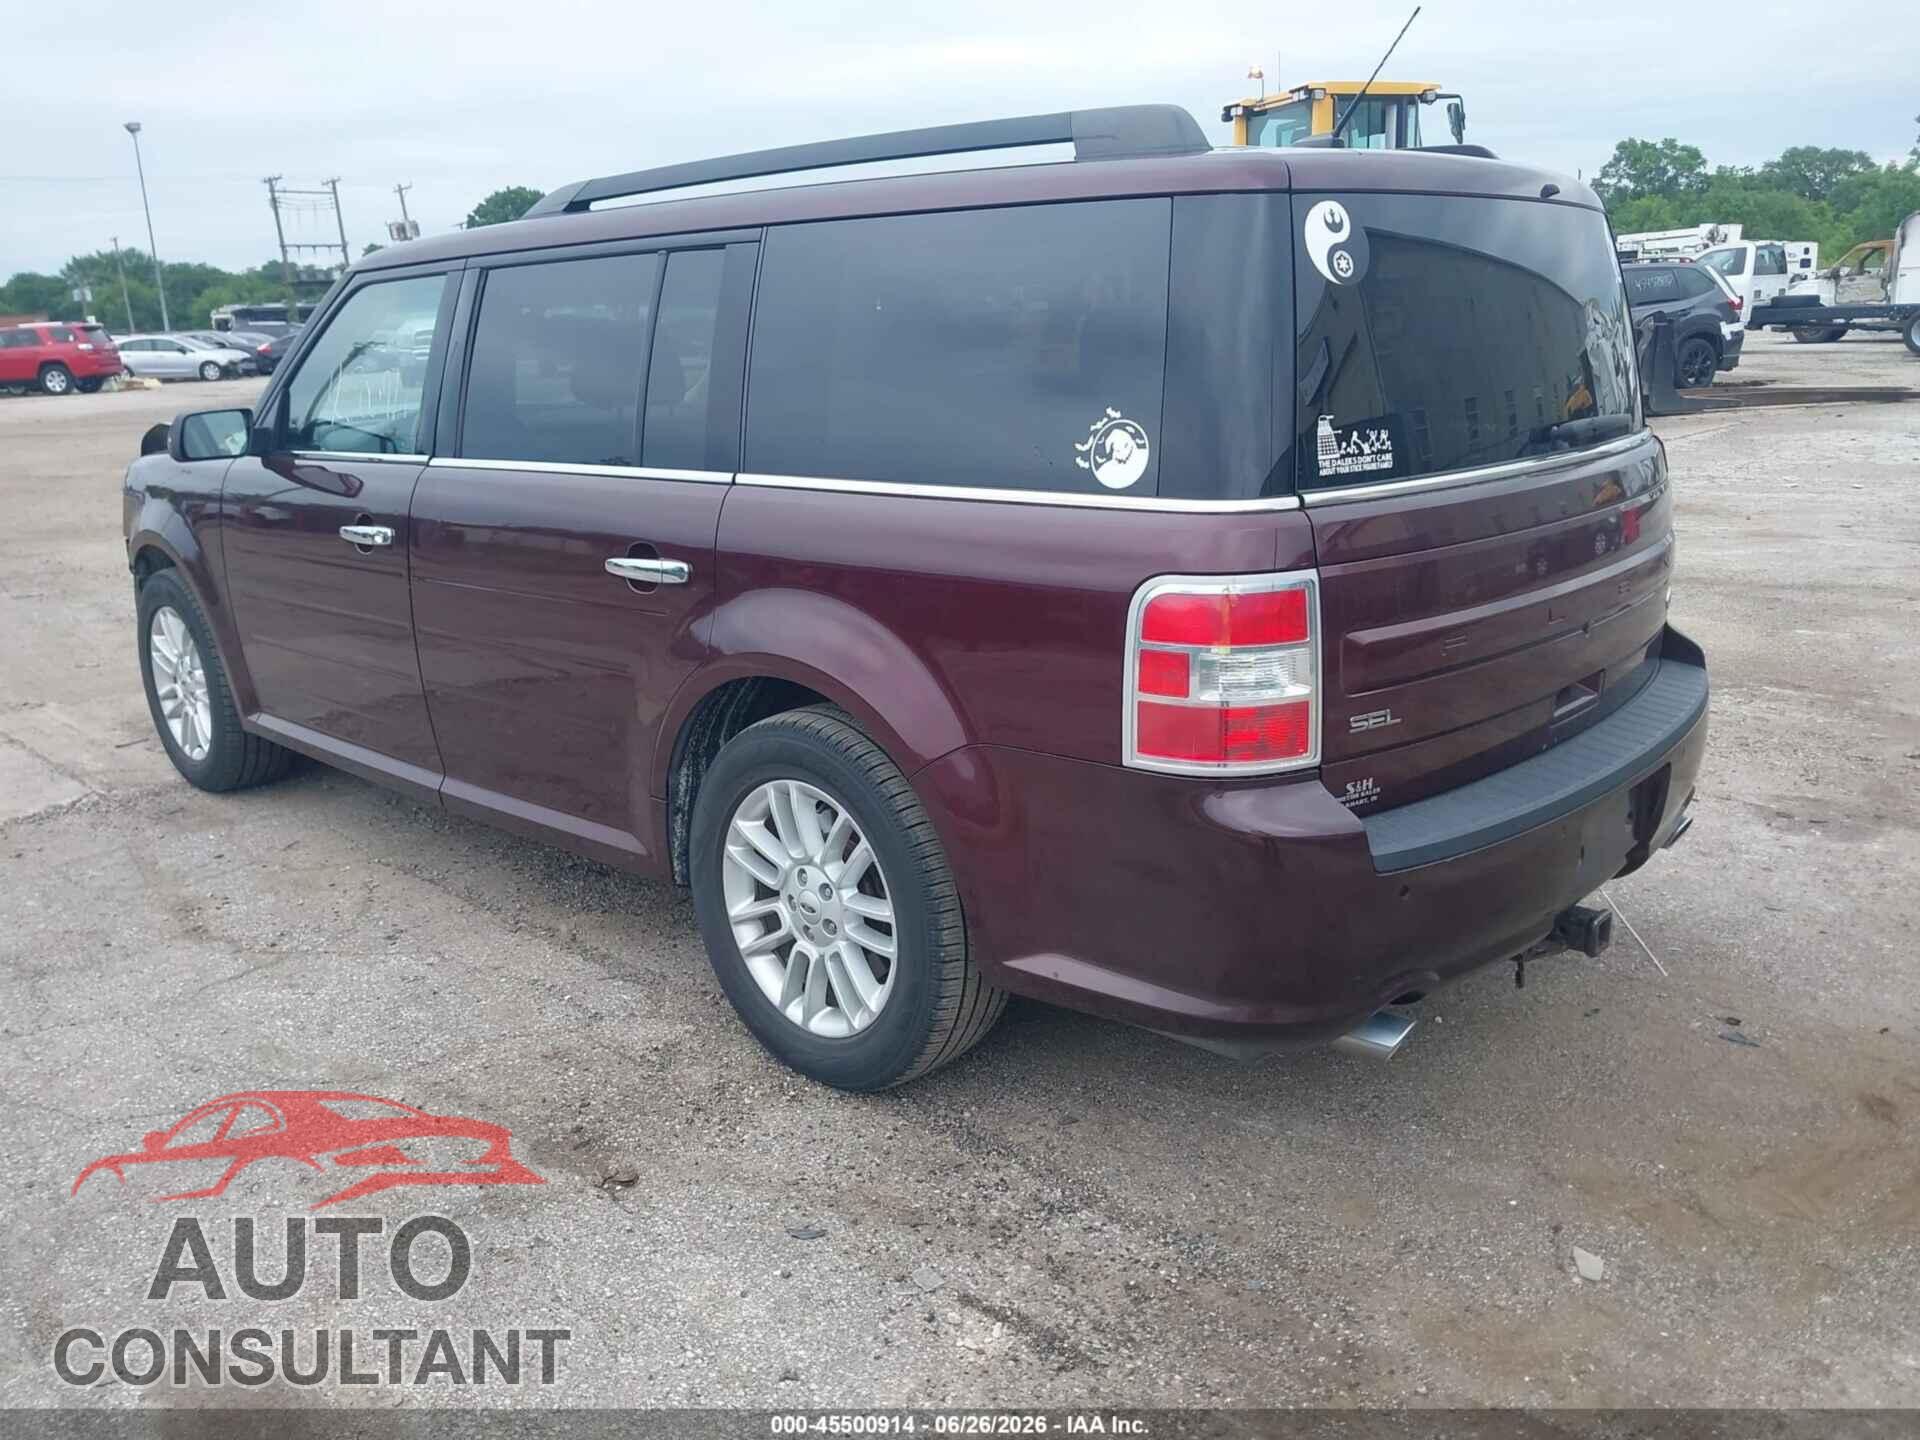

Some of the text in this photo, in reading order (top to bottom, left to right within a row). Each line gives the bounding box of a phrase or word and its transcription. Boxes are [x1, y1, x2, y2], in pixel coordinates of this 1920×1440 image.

[1319, 458, 1331, 468] THE
[1377, 453, 1392, 461] CARE
[1349, 708, 1402, 734] SEL
